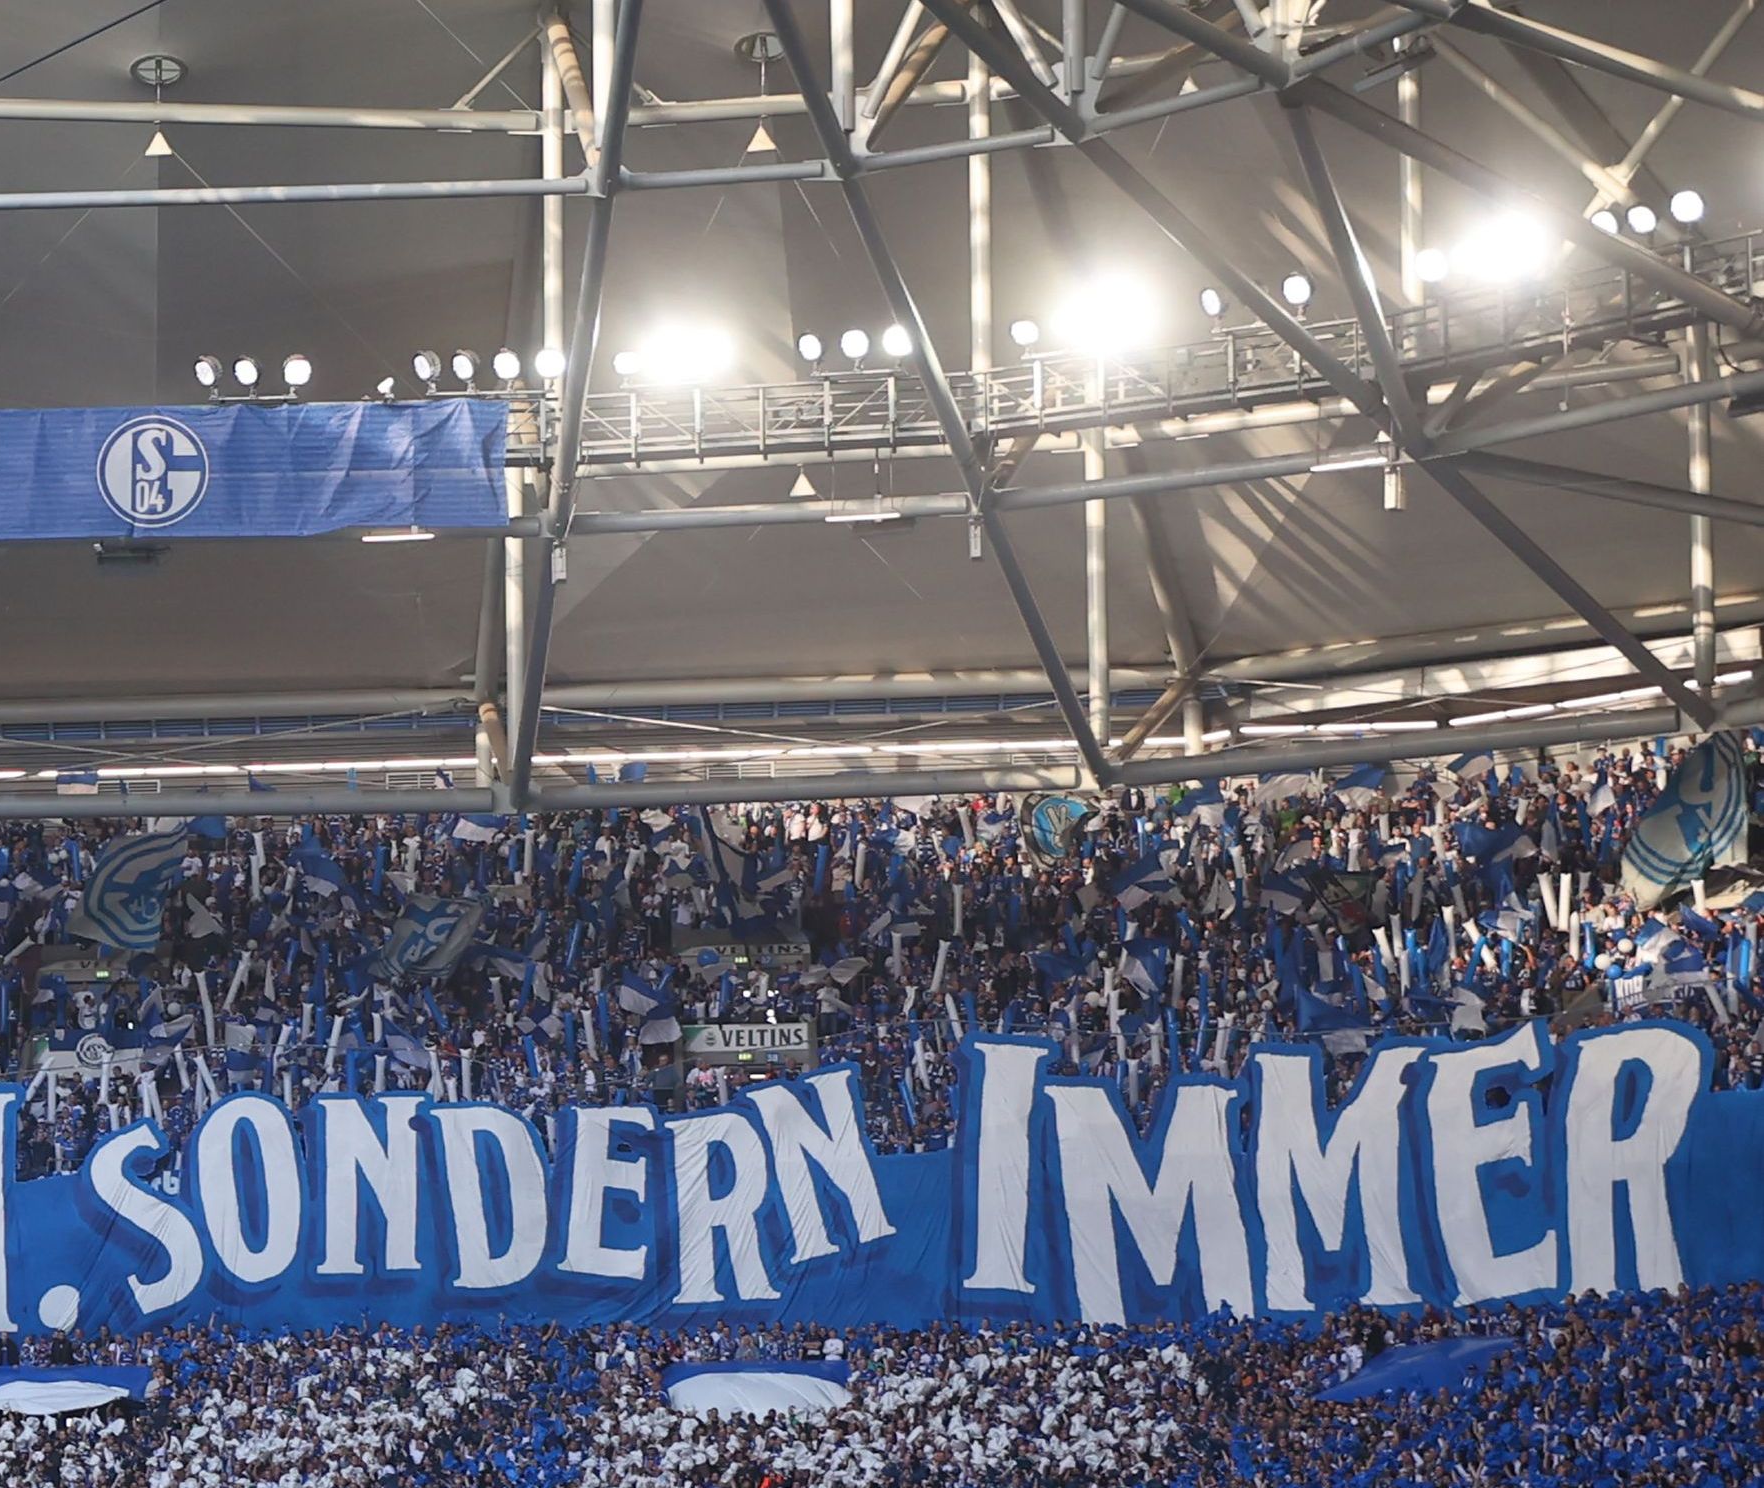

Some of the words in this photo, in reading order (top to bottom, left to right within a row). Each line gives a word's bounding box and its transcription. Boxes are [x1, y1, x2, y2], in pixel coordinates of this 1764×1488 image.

[722, 1029, 803, 1046] VELTINS
[88, 1069, 897, 1317] SONDERN
[961, 1028, 1706, 1327] IMMER
